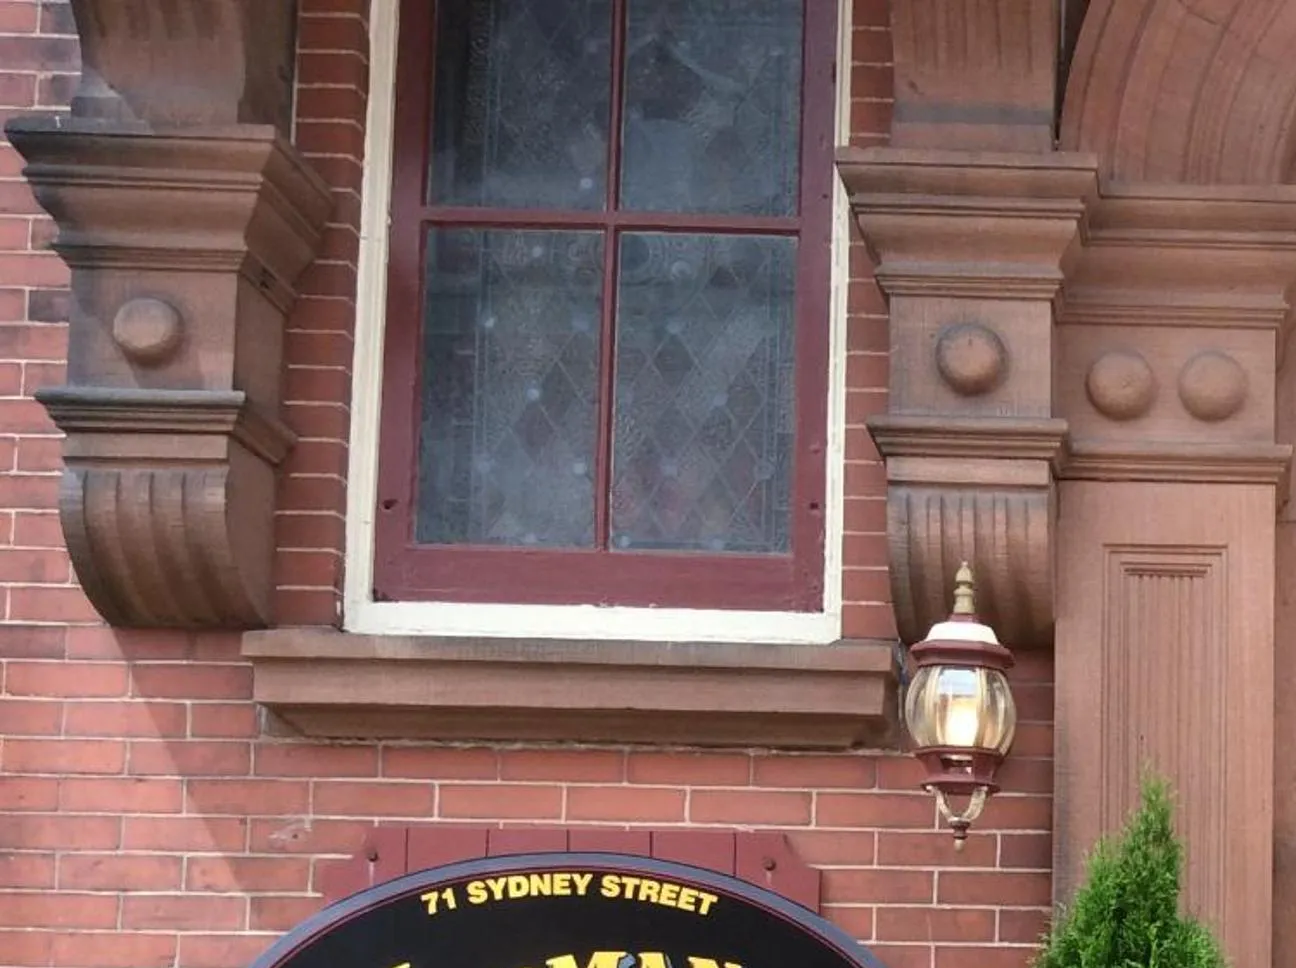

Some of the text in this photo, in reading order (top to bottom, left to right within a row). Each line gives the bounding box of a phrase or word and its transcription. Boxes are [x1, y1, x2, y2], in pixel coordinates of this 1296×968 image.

[421, 873, 718, 915] 71 SYDNEY STREET
